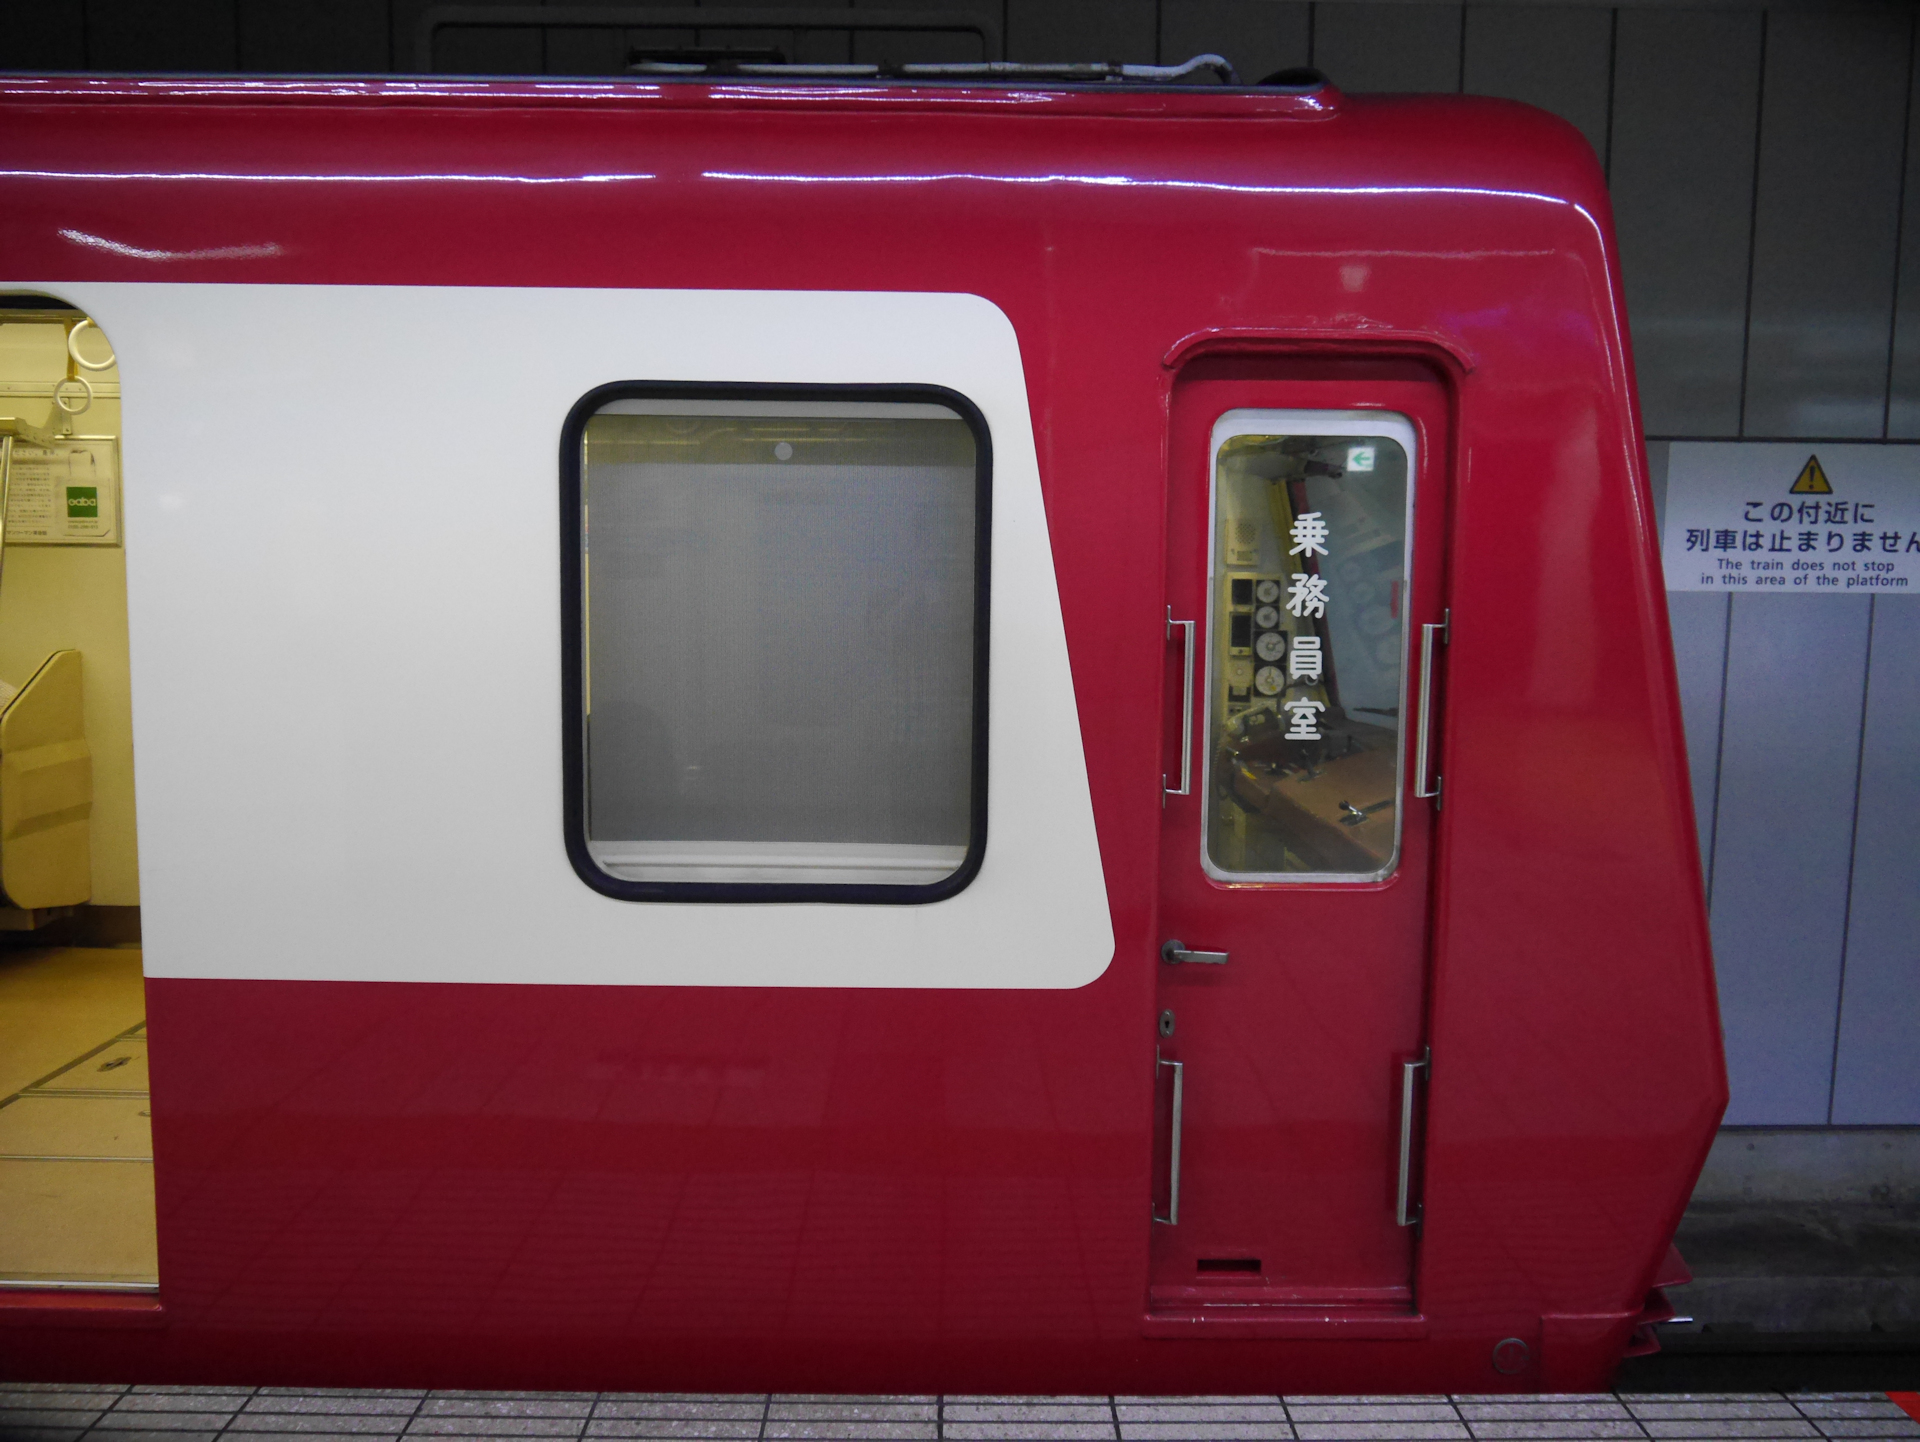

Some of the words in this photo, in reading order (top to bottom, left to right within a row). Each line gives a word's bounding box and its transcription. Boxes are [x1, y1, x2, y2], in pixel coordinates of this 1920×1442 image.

[1744, 501, 1876, 525] この付近に
[1717, 558, 1743, 571] The
[1750, 558, 1784, 571] train
[1791, 558, 1825, 572] does
[1832, 560, 1857, 572] not
[1864, 560, 1895, 573] stop
[1701, 573, 1714, 585] in
[1722, 573, 1748, 586] this
[1755, 576, 1786, 586] area
[1793, 573, 1809, 586] of
[1816, 573, 1839, 586] the
[1846, 573, 1909, 588] platform
[1284, 511, 1330, 742] 乗務員室
